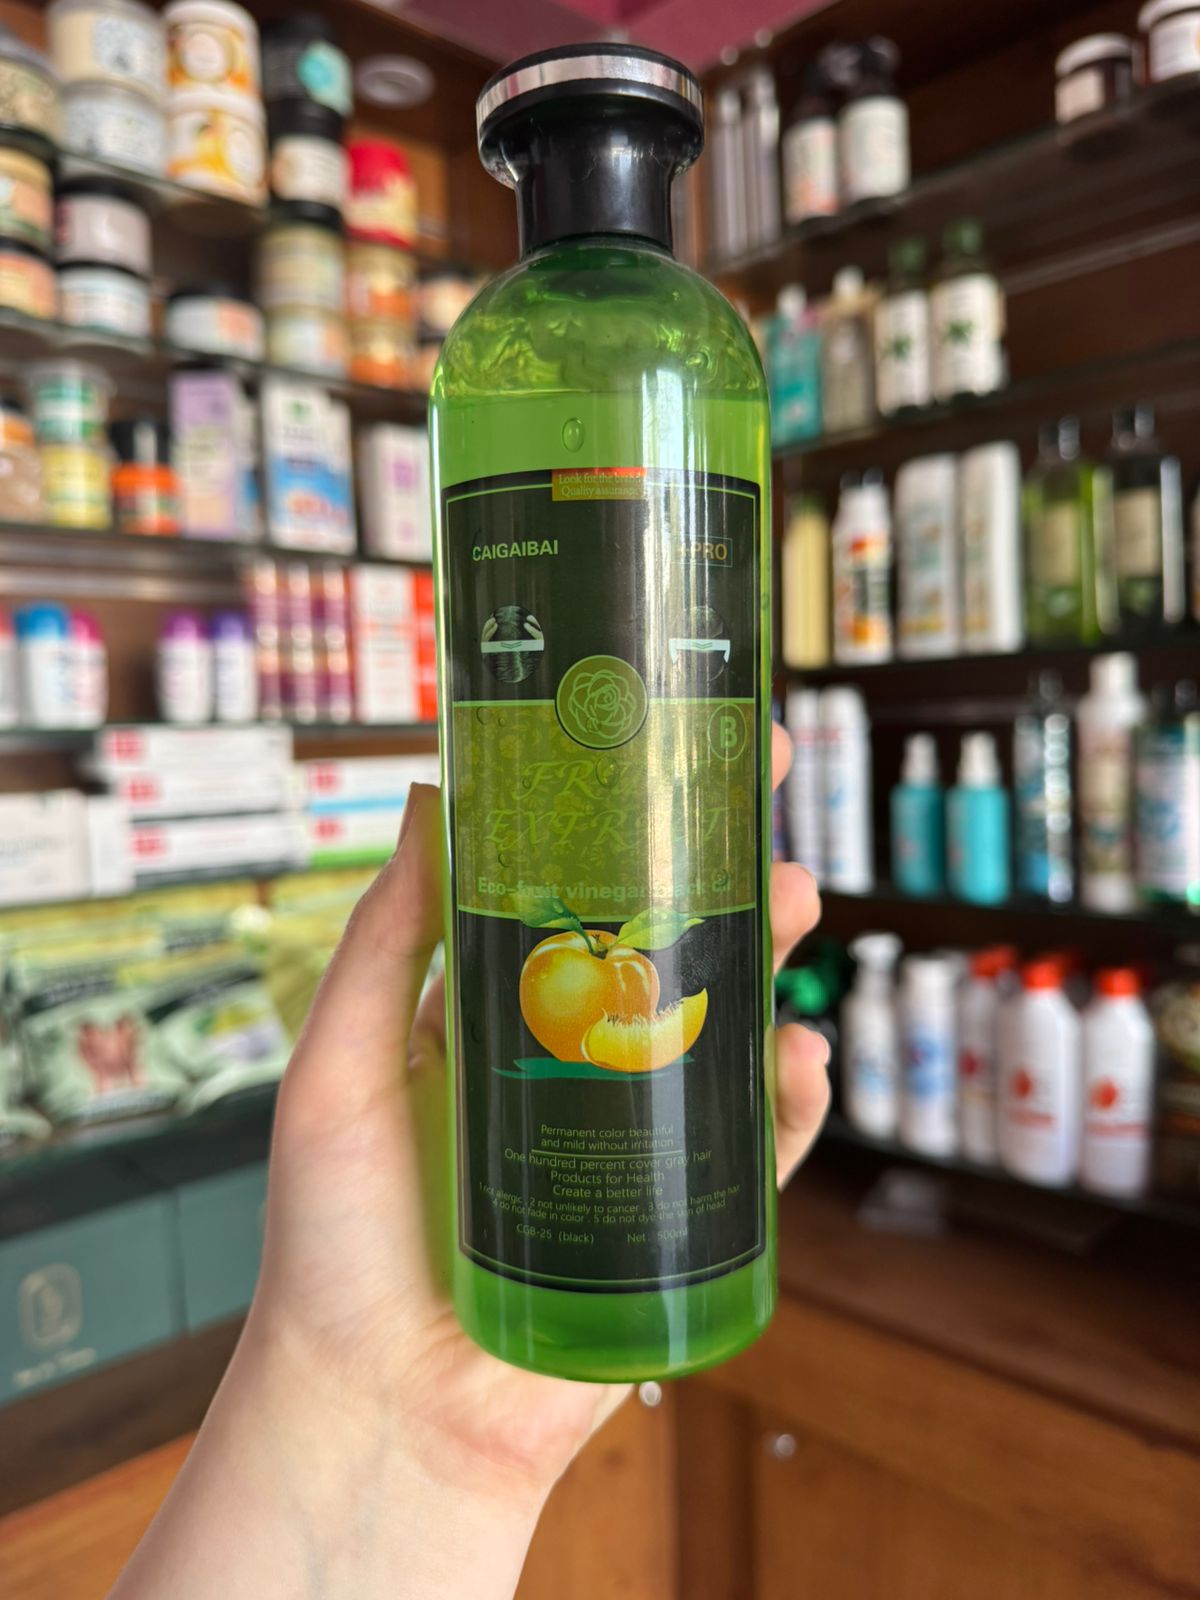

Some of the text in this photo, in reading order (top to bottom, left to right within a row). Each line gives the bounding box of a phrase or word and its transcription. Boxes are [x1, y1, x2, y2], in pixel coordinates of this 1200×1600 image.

[561, 486, 594, 498] Quality
[472, 539, 559, 562] CAIGAIBAI
[719, 716, 738, 749] B
[541, 1123, 674, 1138] Permanent color beautiful
[541, 1138, 560, 1149] and
[563, 1139, 585, 1150] mild
[588, 1140, 628, 1151] without
[504, 1147, 526, 1163] One
[528, 1151, 576, 1169] hundred
[580, 1158, 626, 1172] percent
[692, 1148, 712, 1164] hair
[550, 1170, 665, 1184] Products for Health
[552, 1184, 591, 1199] Create
[594, 1188, 603, 1199] a
[606, 1186, 641, 1199] better
[537, 1199, 554, 1210] not
[555, 1202, 592, 1216] unlikely
[594, 1204, 605, 1214] to
[606, 1204, 640, 1215] cancer
[656, 1199, 672, 1210] do
[673, 1197, 687, 1208] not
[549, 1210, 559, 1221] in
[560, 1213, 585, 1223] color
[593, 1214, 601, 1224] 5
[602, 1213, 617, 1224] do
[618, 1213, 637, 1223] not
[558, 1231, 595, 1246] (black)
